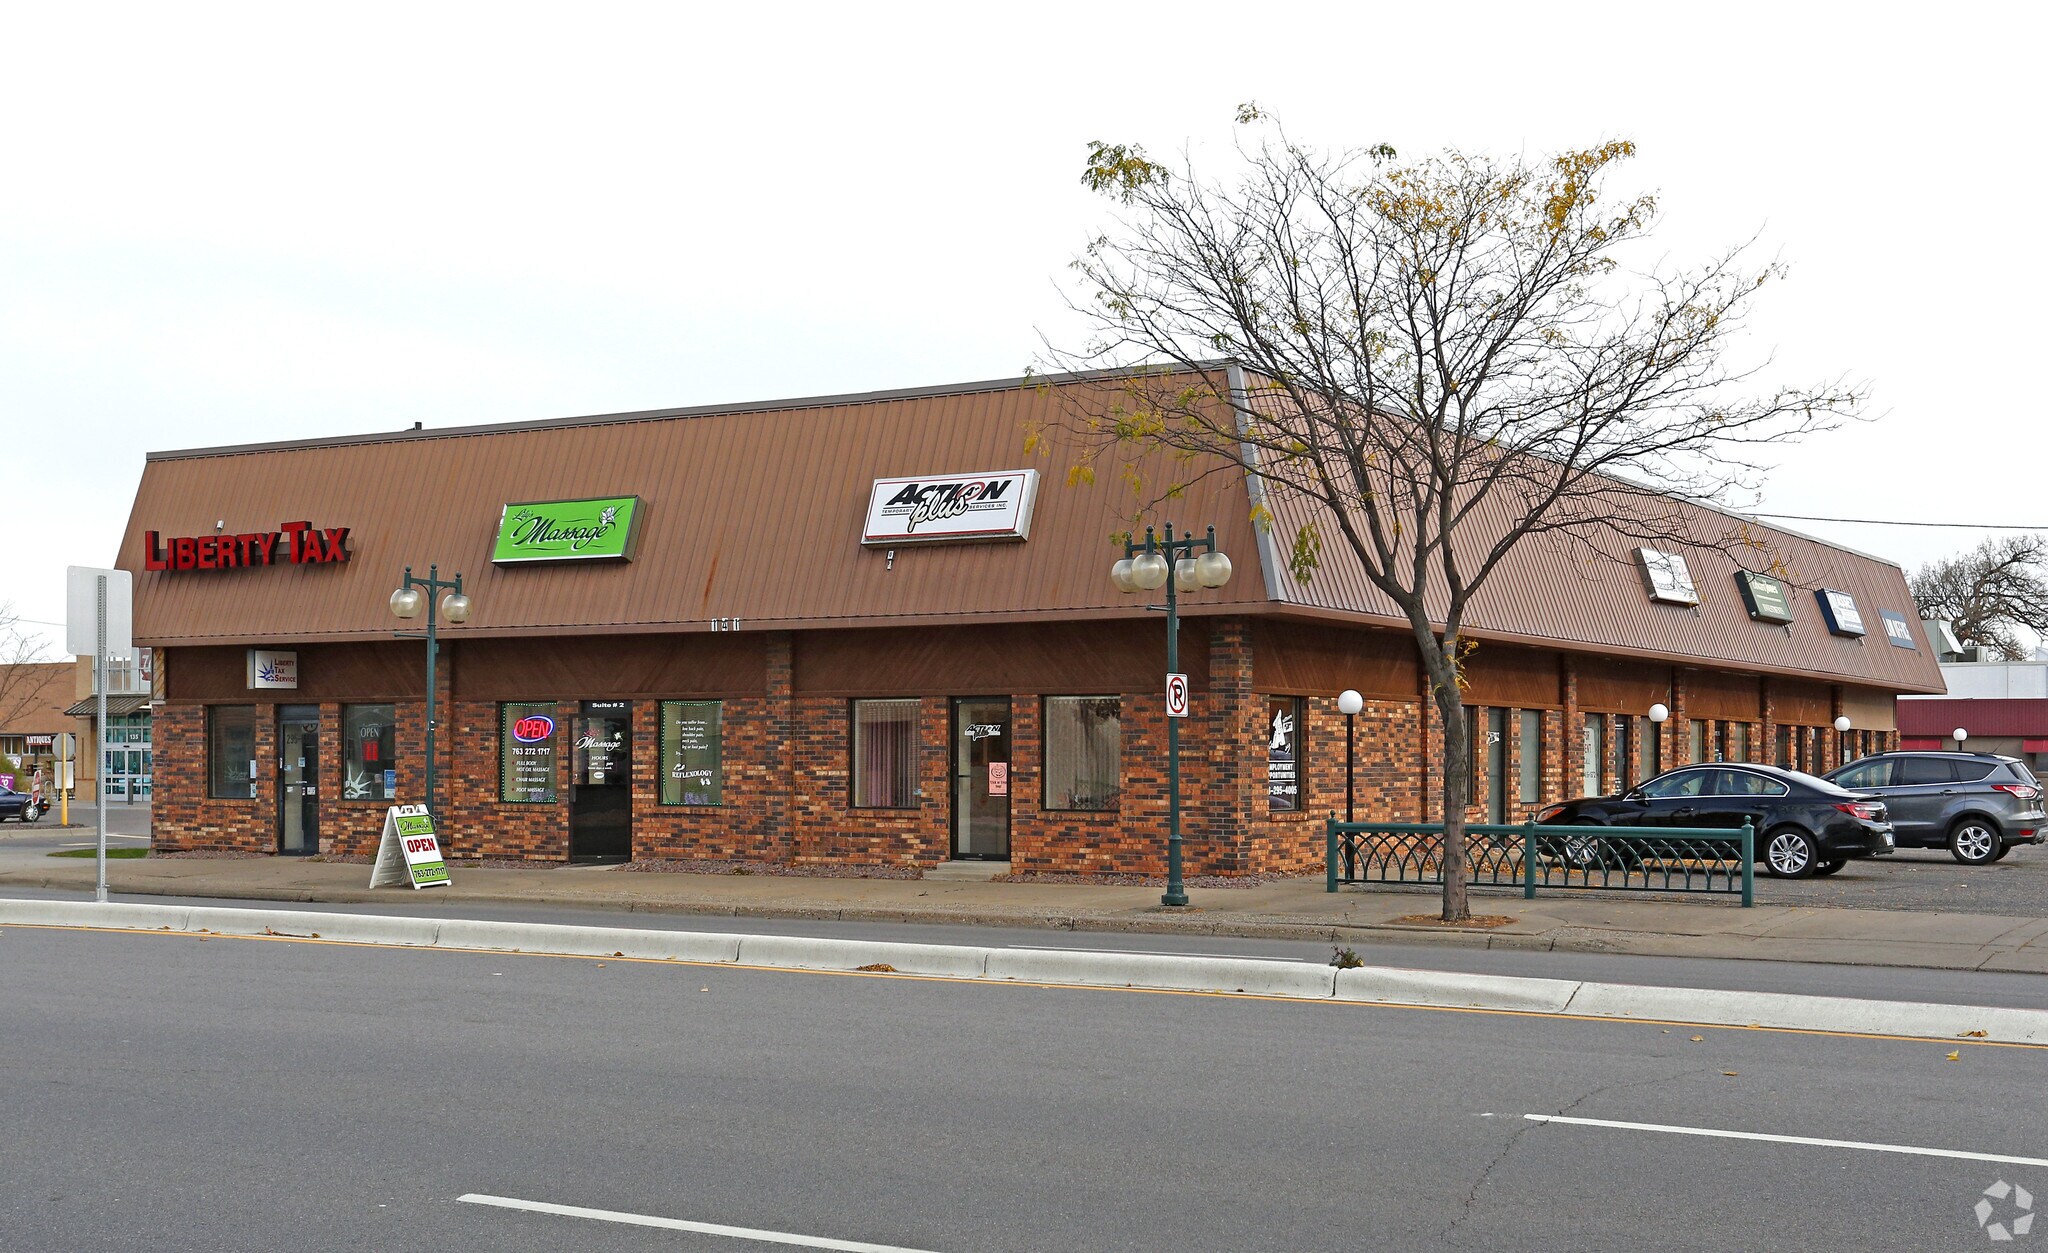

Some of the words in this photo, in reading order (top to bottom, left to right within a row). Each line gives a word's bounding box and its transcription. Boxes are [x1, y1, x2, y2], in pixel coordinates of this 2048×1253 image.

[908, 491, 969, 533] plus
[510, 516, 608, 551] Massage
[145, 531, 281, 571] LIBERTY
[281, 521, 350, 564] TAX
[712, 618, 740, 632] 141
[361, 728, 379, 737] OPEN
[515, 719, 549, 738] OPEN
[26, 736, 51, 744] ANTIQUES
[576, 736, 620, 751] Massage
[672, 770, 713, 778] REFLEXOLOGY
[1269, 785, 1297, 795] -295-4005
[407, 838, 436, 853] OPEN
[414, 867, 446, 878] 763-272-1717
